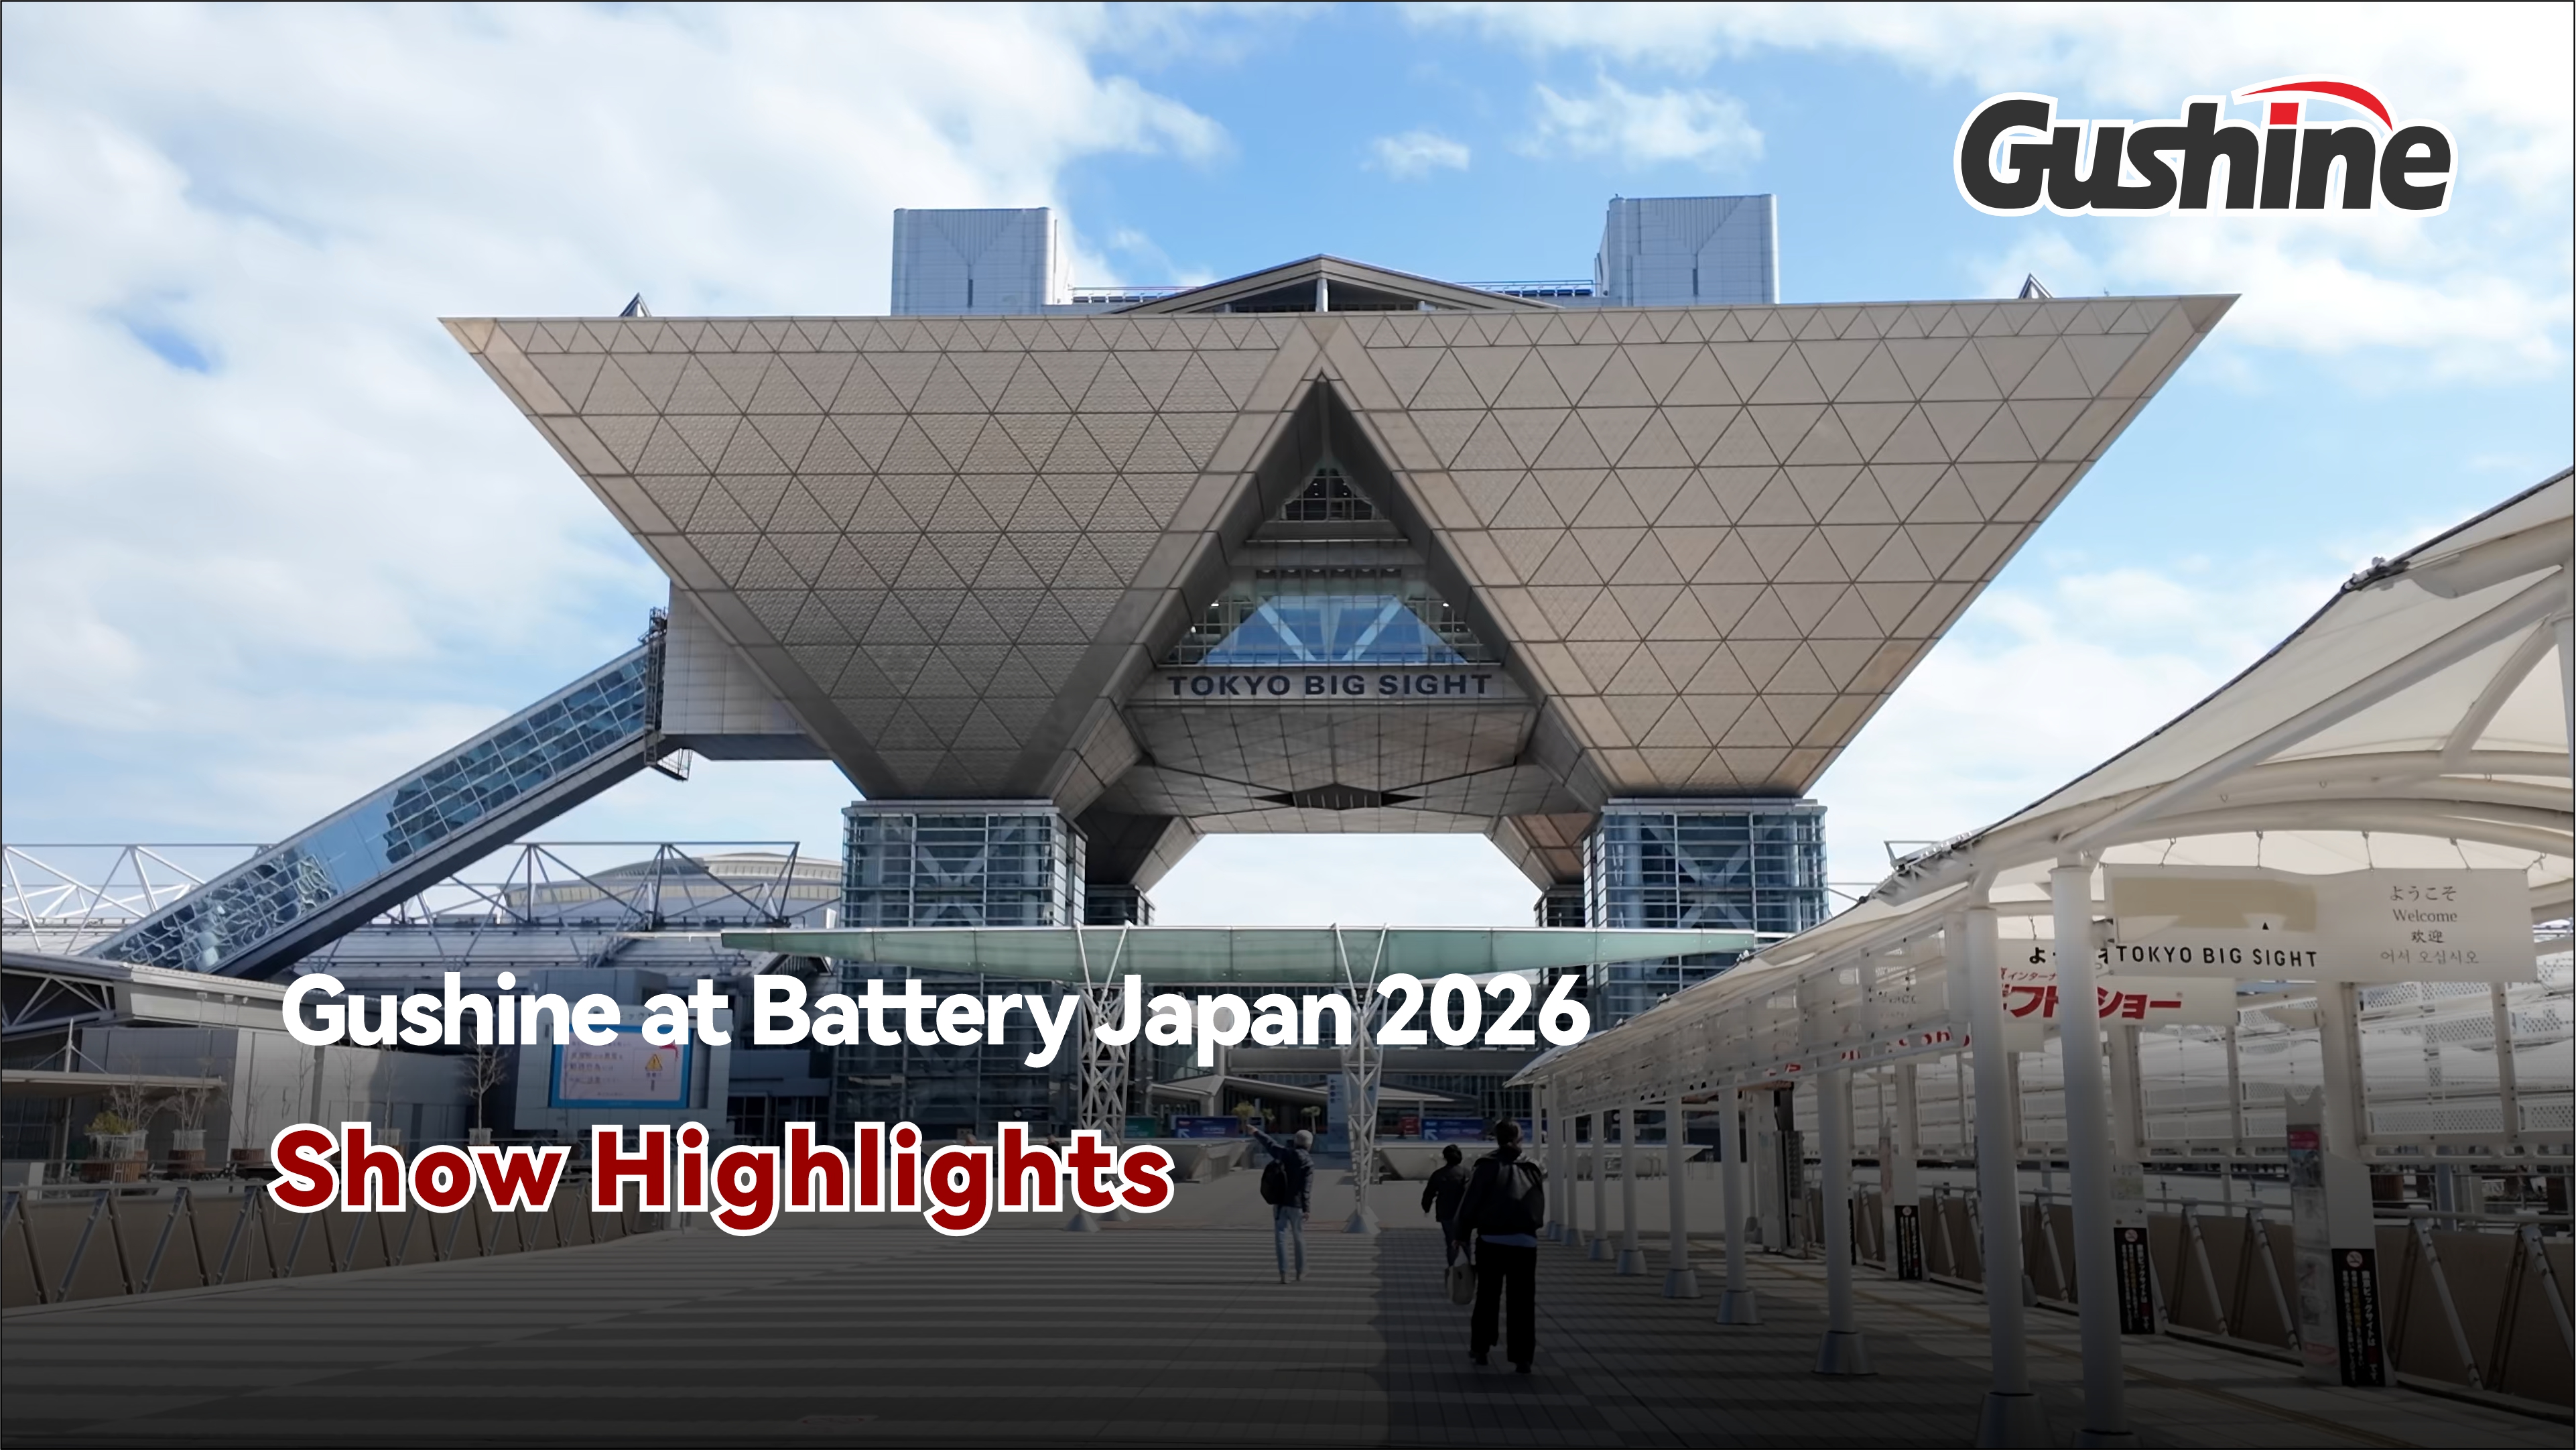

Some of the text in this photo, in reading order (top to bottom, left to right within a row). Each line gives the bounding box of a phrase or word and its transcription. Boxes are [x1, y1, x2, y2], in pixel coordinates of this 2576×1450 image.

[1167, 674, 1492, 696] TOKYO BIG SIGHT
[2390, 886, 2457, 902] ようこそ
[2392, 908, 2458, 922] Welcome
[2411, 929, 2445, 943] 欢迎
[2116, 945, 2317, 968] TOKYO BIG SIGHT
[2380, 949, 2480, 965] 어서 오십시오
